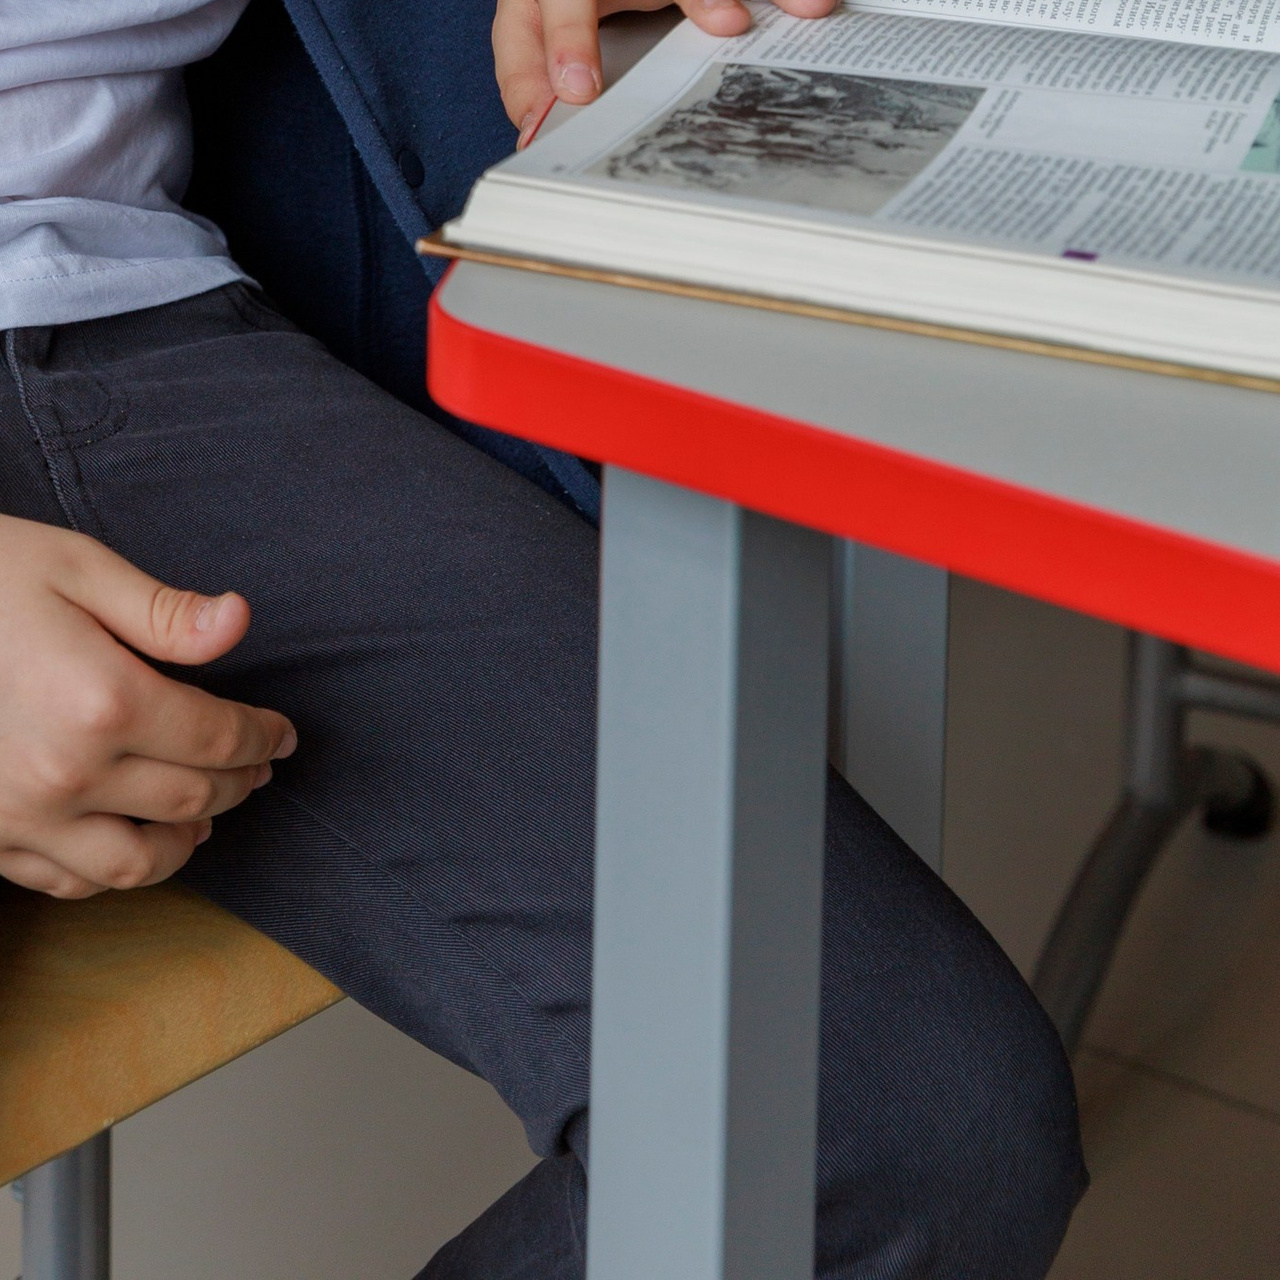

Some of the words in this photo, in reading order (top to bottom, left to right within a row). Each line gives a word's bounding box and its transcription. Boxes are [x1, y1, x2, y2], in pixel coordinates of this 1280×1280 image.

[1062, 1, 1075, 21] слу-
[1139, 2, 1156, 30] Индо-
[1152, 4, 1167, 31] прак-
[1177, 13, 1189, 34] тру-
[1205, 16, 1215, 37] рас-
[1218, 14, 1232, 39] При-
[1231, 24, 1240, 41] ан-
